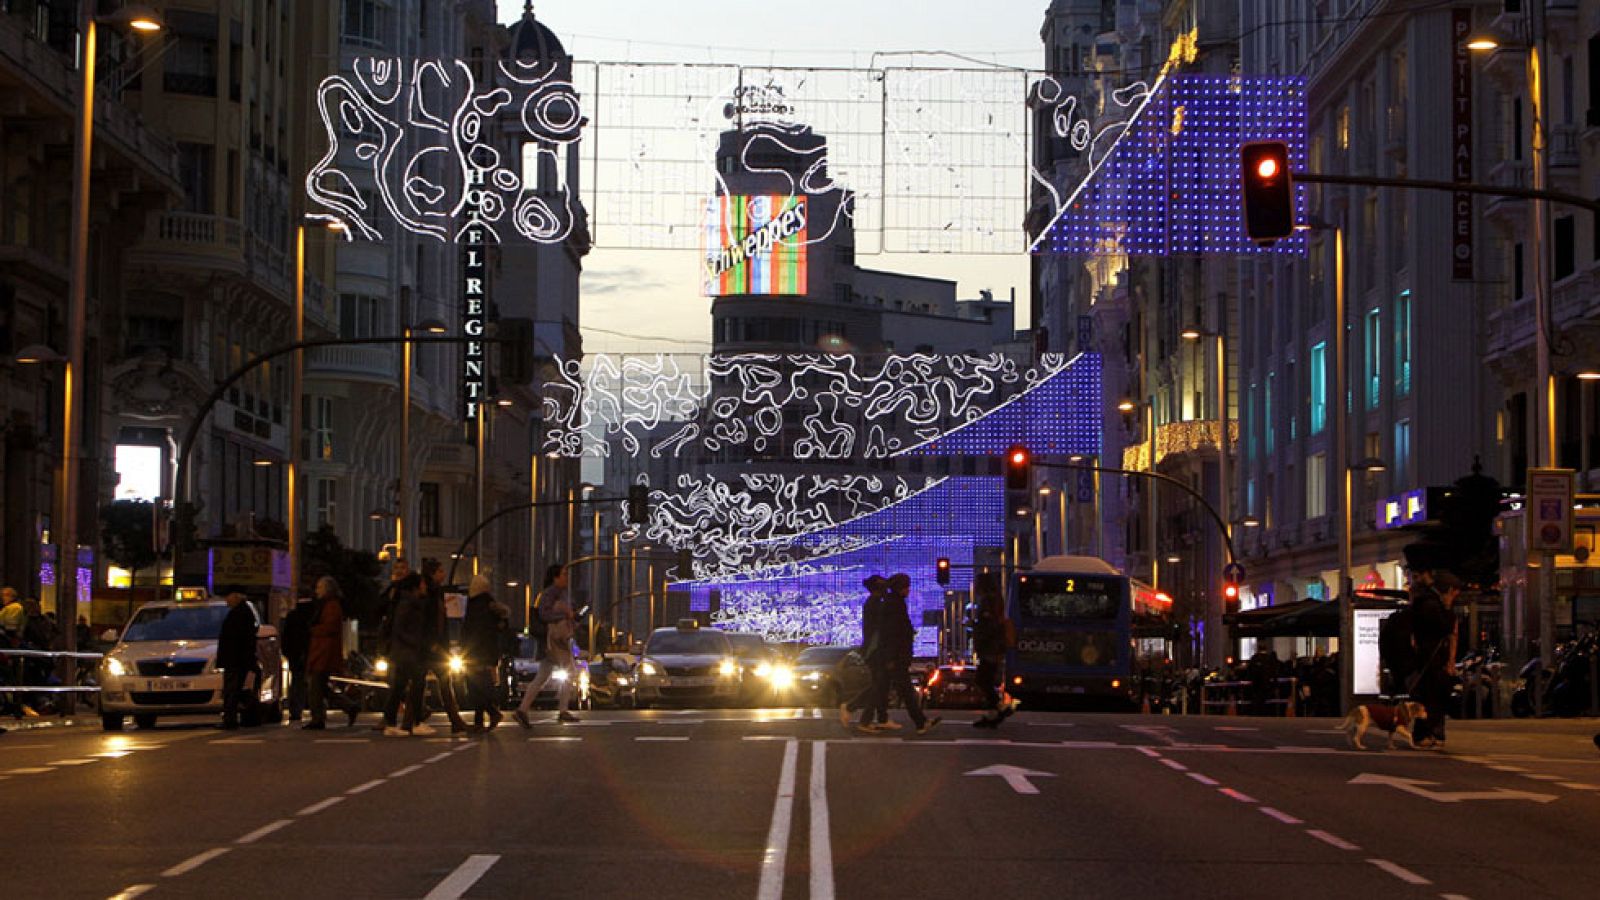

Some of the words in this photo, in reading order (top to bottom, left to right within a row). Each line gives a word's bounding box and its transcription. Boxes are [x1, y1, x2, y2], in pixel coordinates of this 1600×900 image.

[1455, 21, 1469, 113] PETIT
[466, 169, 485, 267] HOTEL
[1065, 579, 1075, 592] 2
